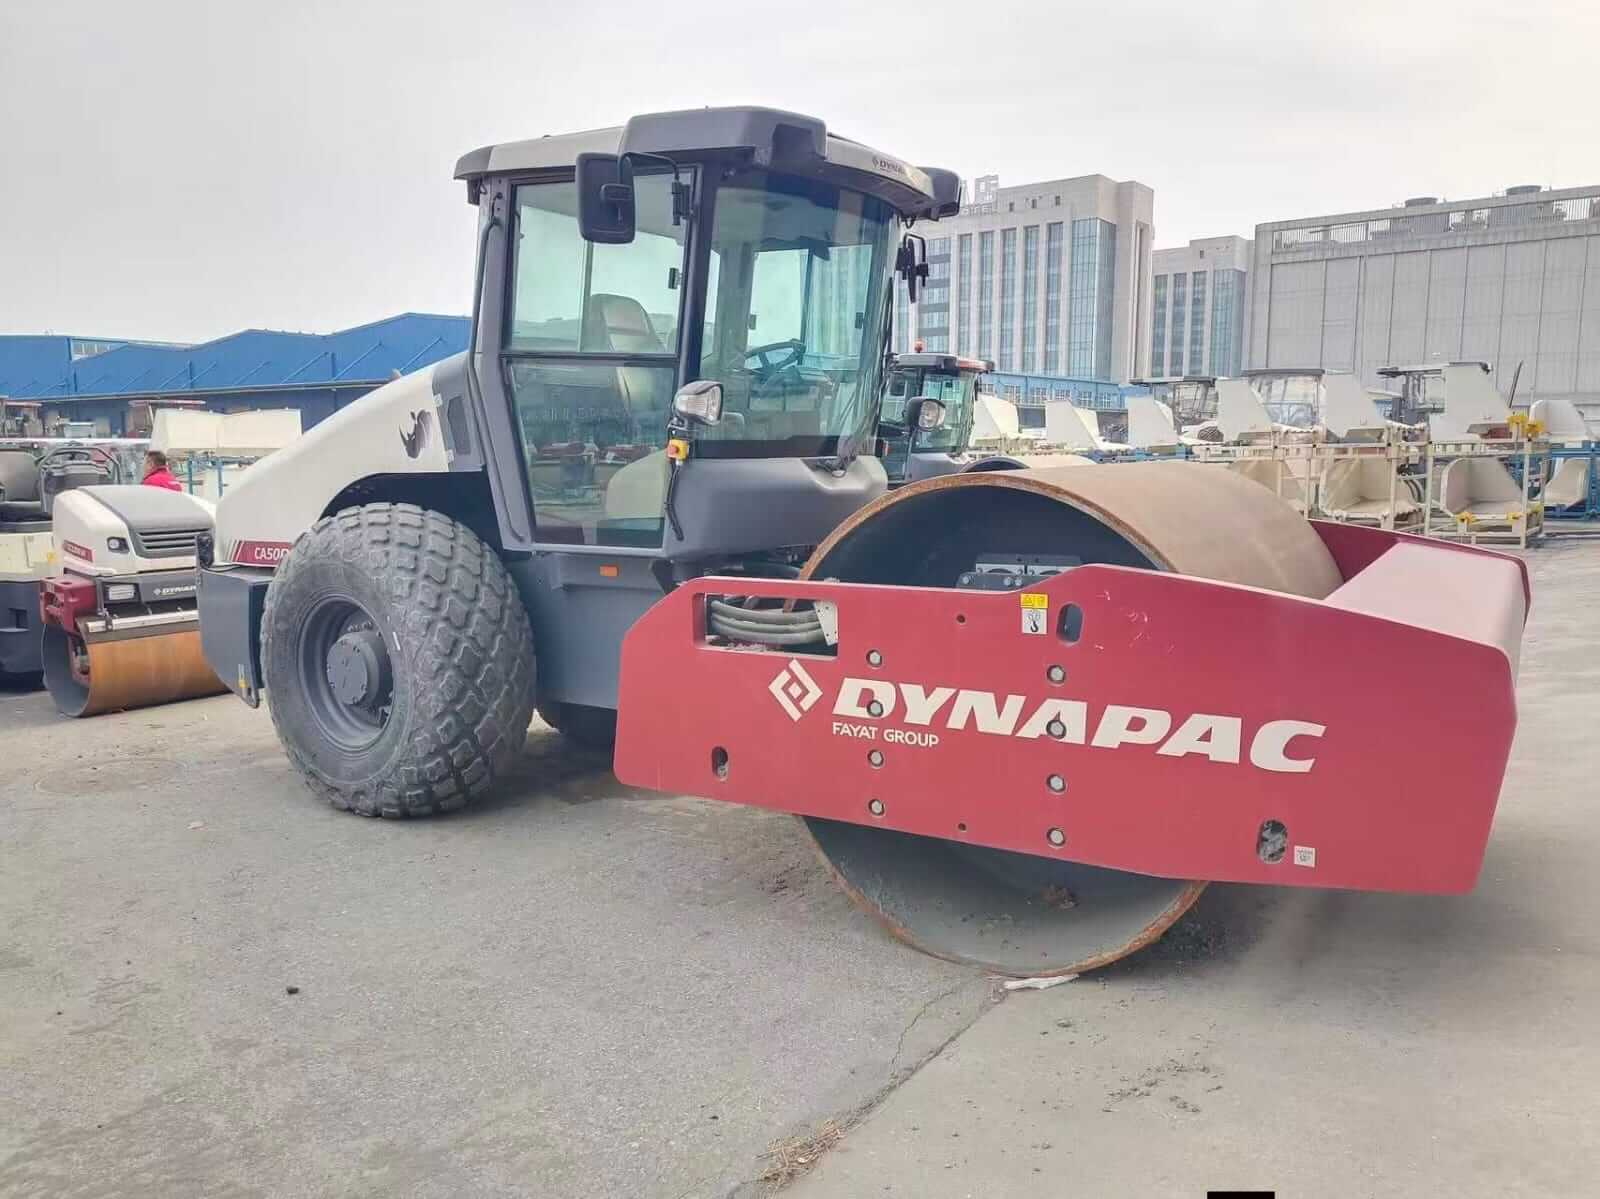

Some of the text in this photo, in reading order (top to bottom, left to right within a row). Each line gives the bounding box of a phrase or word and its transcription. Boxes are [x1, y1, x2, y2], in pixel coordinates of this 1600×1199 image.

[832, 677, 1326, 773] DYNAPAC
[832, 722, 940, 748] FAYAT GROUP
